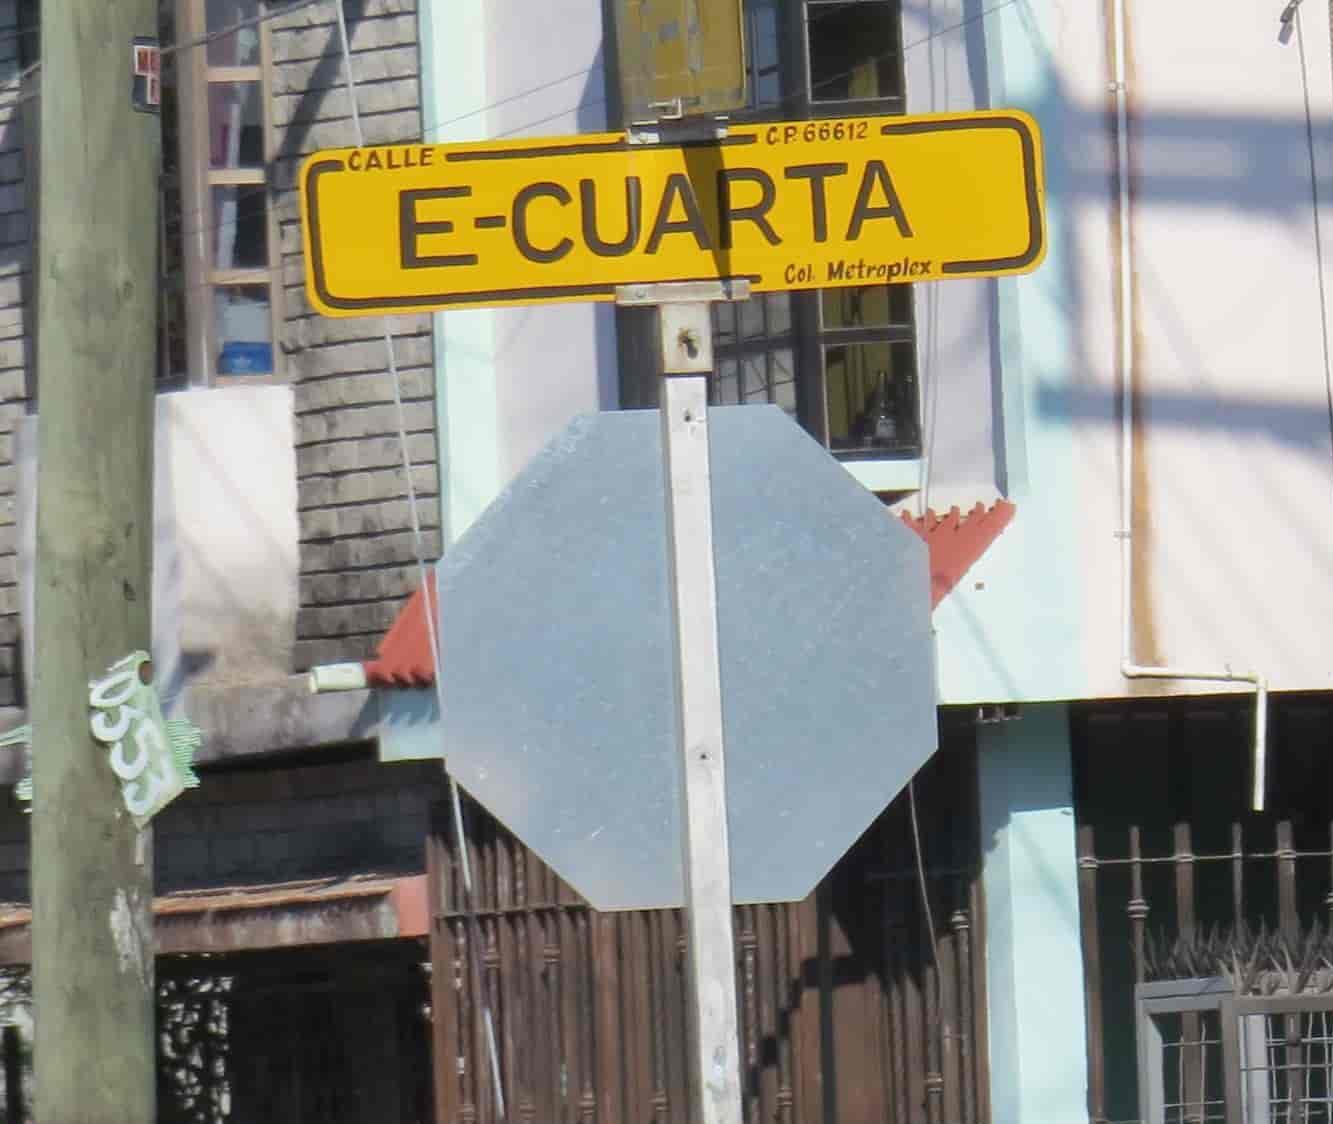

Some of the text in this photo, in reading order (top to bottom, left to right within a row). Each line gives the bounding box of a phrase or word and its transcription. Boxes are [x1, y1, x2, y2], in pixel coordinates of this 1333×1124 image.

[803, 121, 868, 142] 66612
[347, 147, 435, 171] CALLE
[397, 159, 915, 270] E-CUARTA
[827, 257, 932, 282] Metroplex
